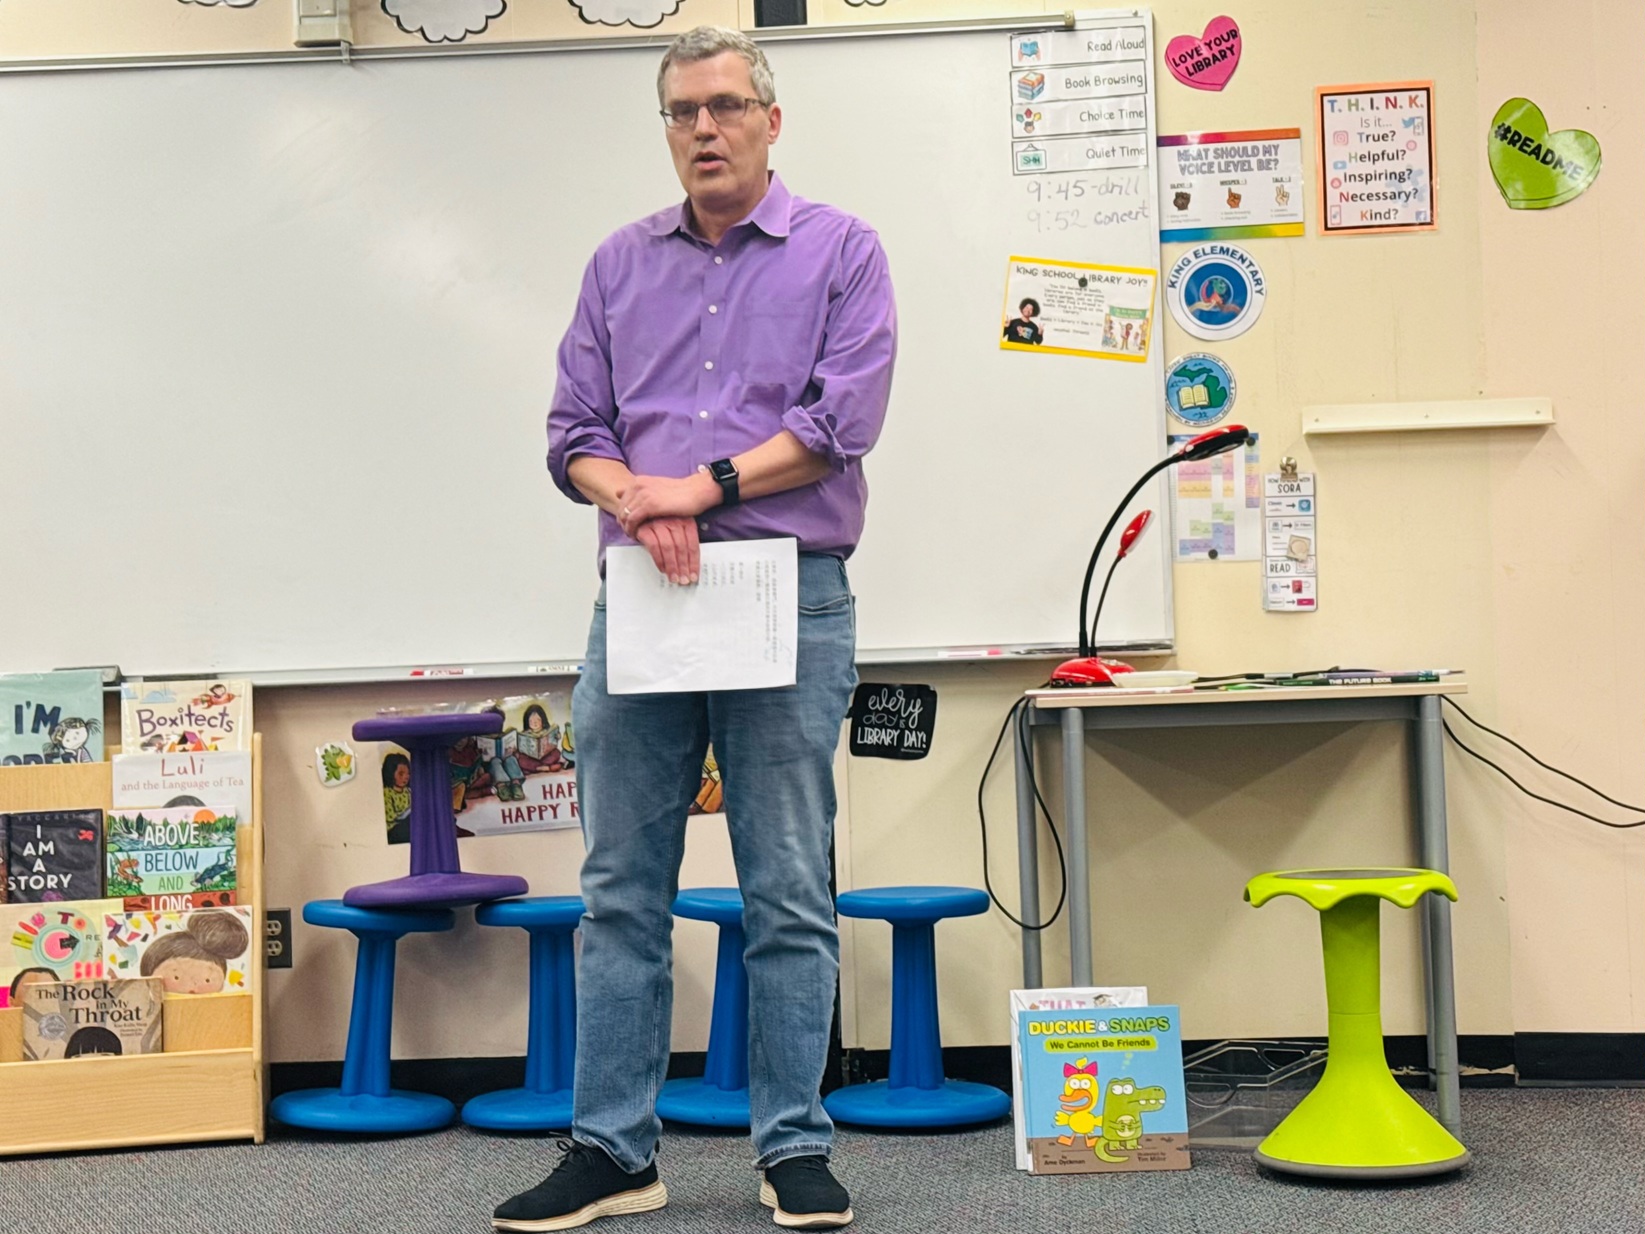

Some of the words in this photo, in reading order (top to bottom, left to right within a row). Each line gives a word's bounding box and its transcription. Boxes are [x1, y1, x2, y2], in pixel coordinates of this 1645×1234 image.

[1087, 41, 1112, 52] Read
[1172, 44, 1202, 68] LOVE
[1204, 28, 1238, 54] YOUR
[1185, 44, 1236, 77] LIBRARY
[1065, 77, 1090, 89] Book
[1094, 74, 1143, 87] Browsing
[1080, 110, 1115, 122] Choice
[1119, 109, 1144, 120] Time
[1357, 130, 1396, 143] True?
[1086, 148, 1116, 159] Quiet
[1121, 146, 1145, 157] Time
[1348, 149, 1406, 165] Helpful?
[1494, 122, 1584, 180] #README
[1344, 169, 1413, 184] Inspiring?
[1339, 188, 1418, 203] Necessary?
[1360, 208, 1398, 221] Kind?
[1168, 257, 1191, 289] KING
[1193, 245, 1265, 297] ELEMENTARY
[1278, 483, 1301, 494] SORA
[1270, 563, 1290, 573] READ
[868, 688, 923, 729] every
[14, 701, 61, 735] I'M
[136, 704, 234, 737] Boxitects
[857, 727, 900, 746] LIBRARY
[903, 730, 926, 748] DAY!
[161, 755, 204, 777] Luli
[501, 803, 561, 824] HAPPY
[23, 841, 55, 857] AM
[144, 851, 199, 873] BELOW
[8, 873, 73, 891] STORY
[158, 876, 184, 891] AND
[151, 895, 193, 911] LONG
[36, 989, 60, 1000] The
[62, 985, 115, 1002] Rock
[69, 1006, 143, 1024] Throat
[1028, 1019, 1096, 1036] DUCKIE
[1098, 1021, 1108, 1032] &
[1109, 1016, 1170, 1033] SNAPS
[1050, 1041, 1064, 1050] We
[1067, 1040, 1099, 1050] Cannot
[1102, 1039, 1114, 1048] Be
[1117, 1038, 1150, 1047] Friends
